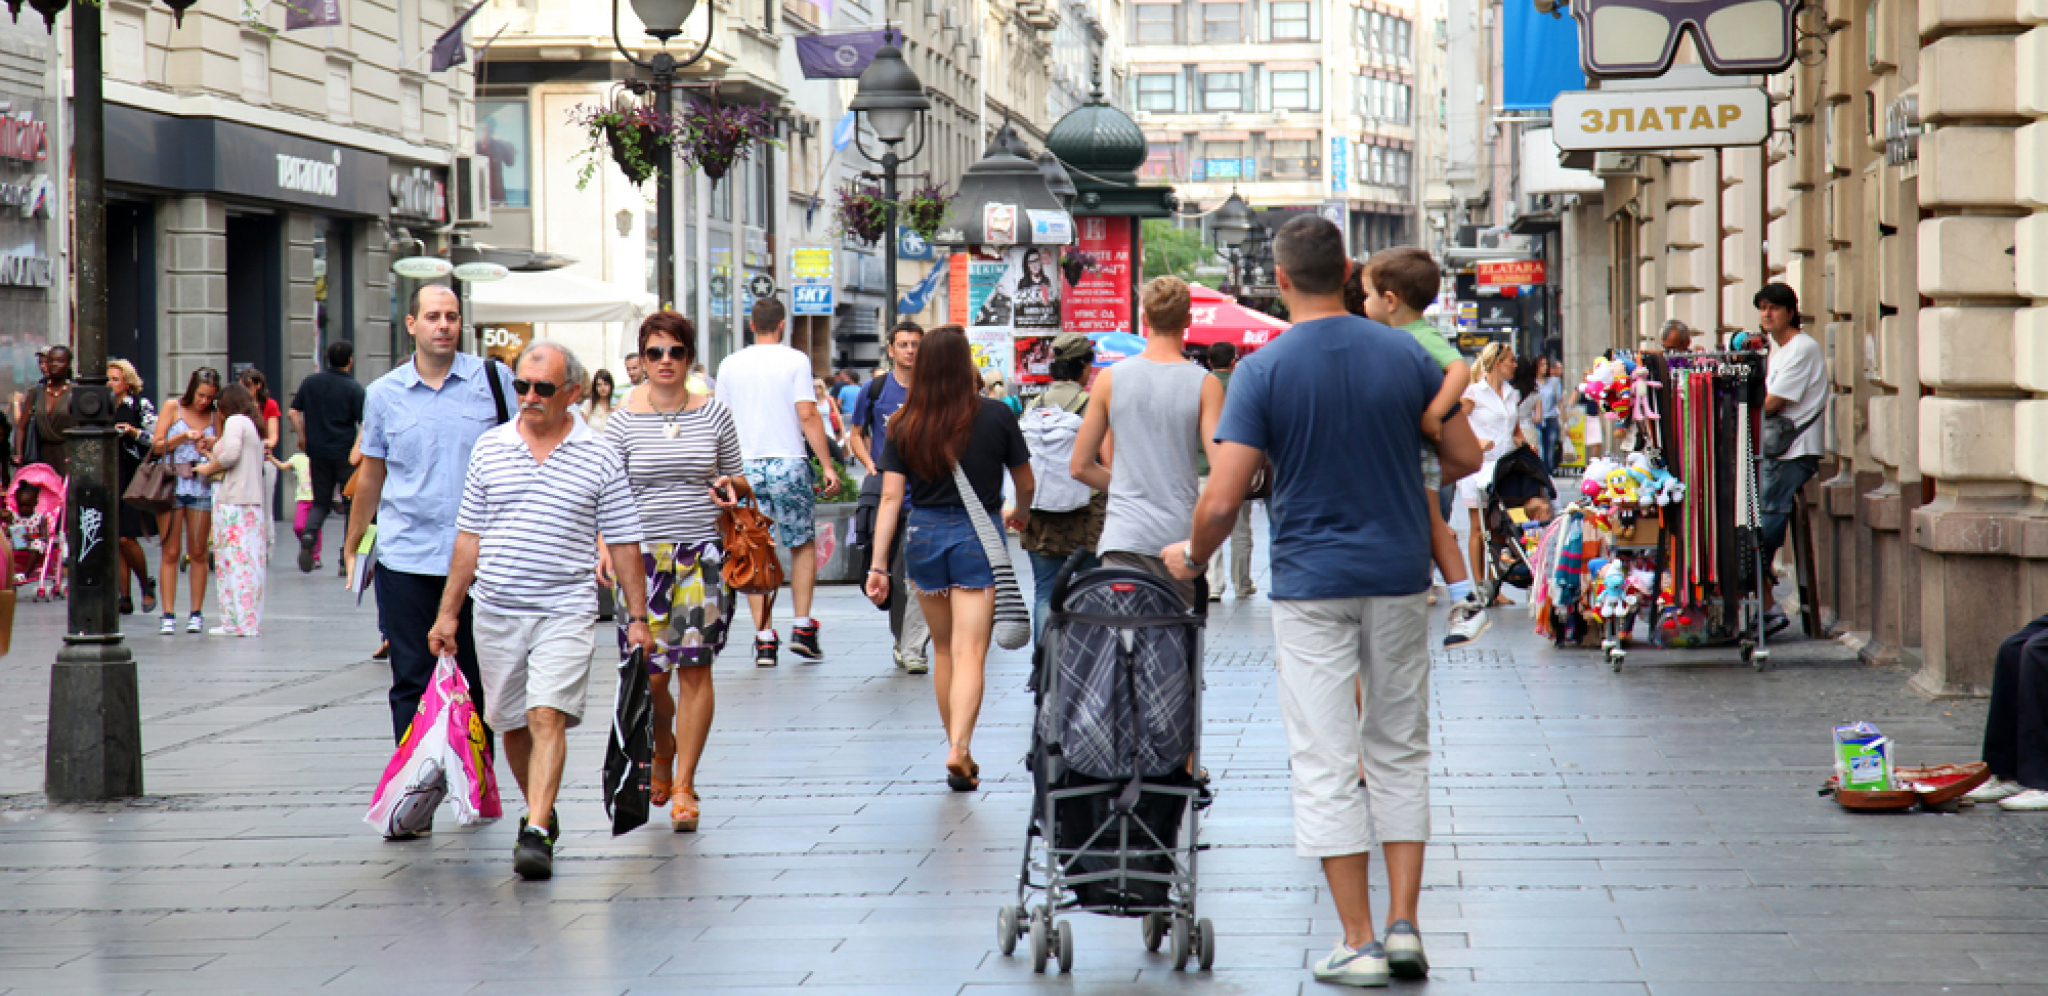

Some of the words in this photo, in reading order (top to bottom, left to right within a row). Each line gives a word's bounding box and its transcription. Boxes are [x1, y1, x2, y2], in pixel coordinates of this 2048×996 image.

[1580, 104, 1742, 133] ЗЛАТАР
[1480, 262, 1543, 274] ZLATARA
[797, 287, 829, 302] SKY
[483, 328, 522, 346] 50%
